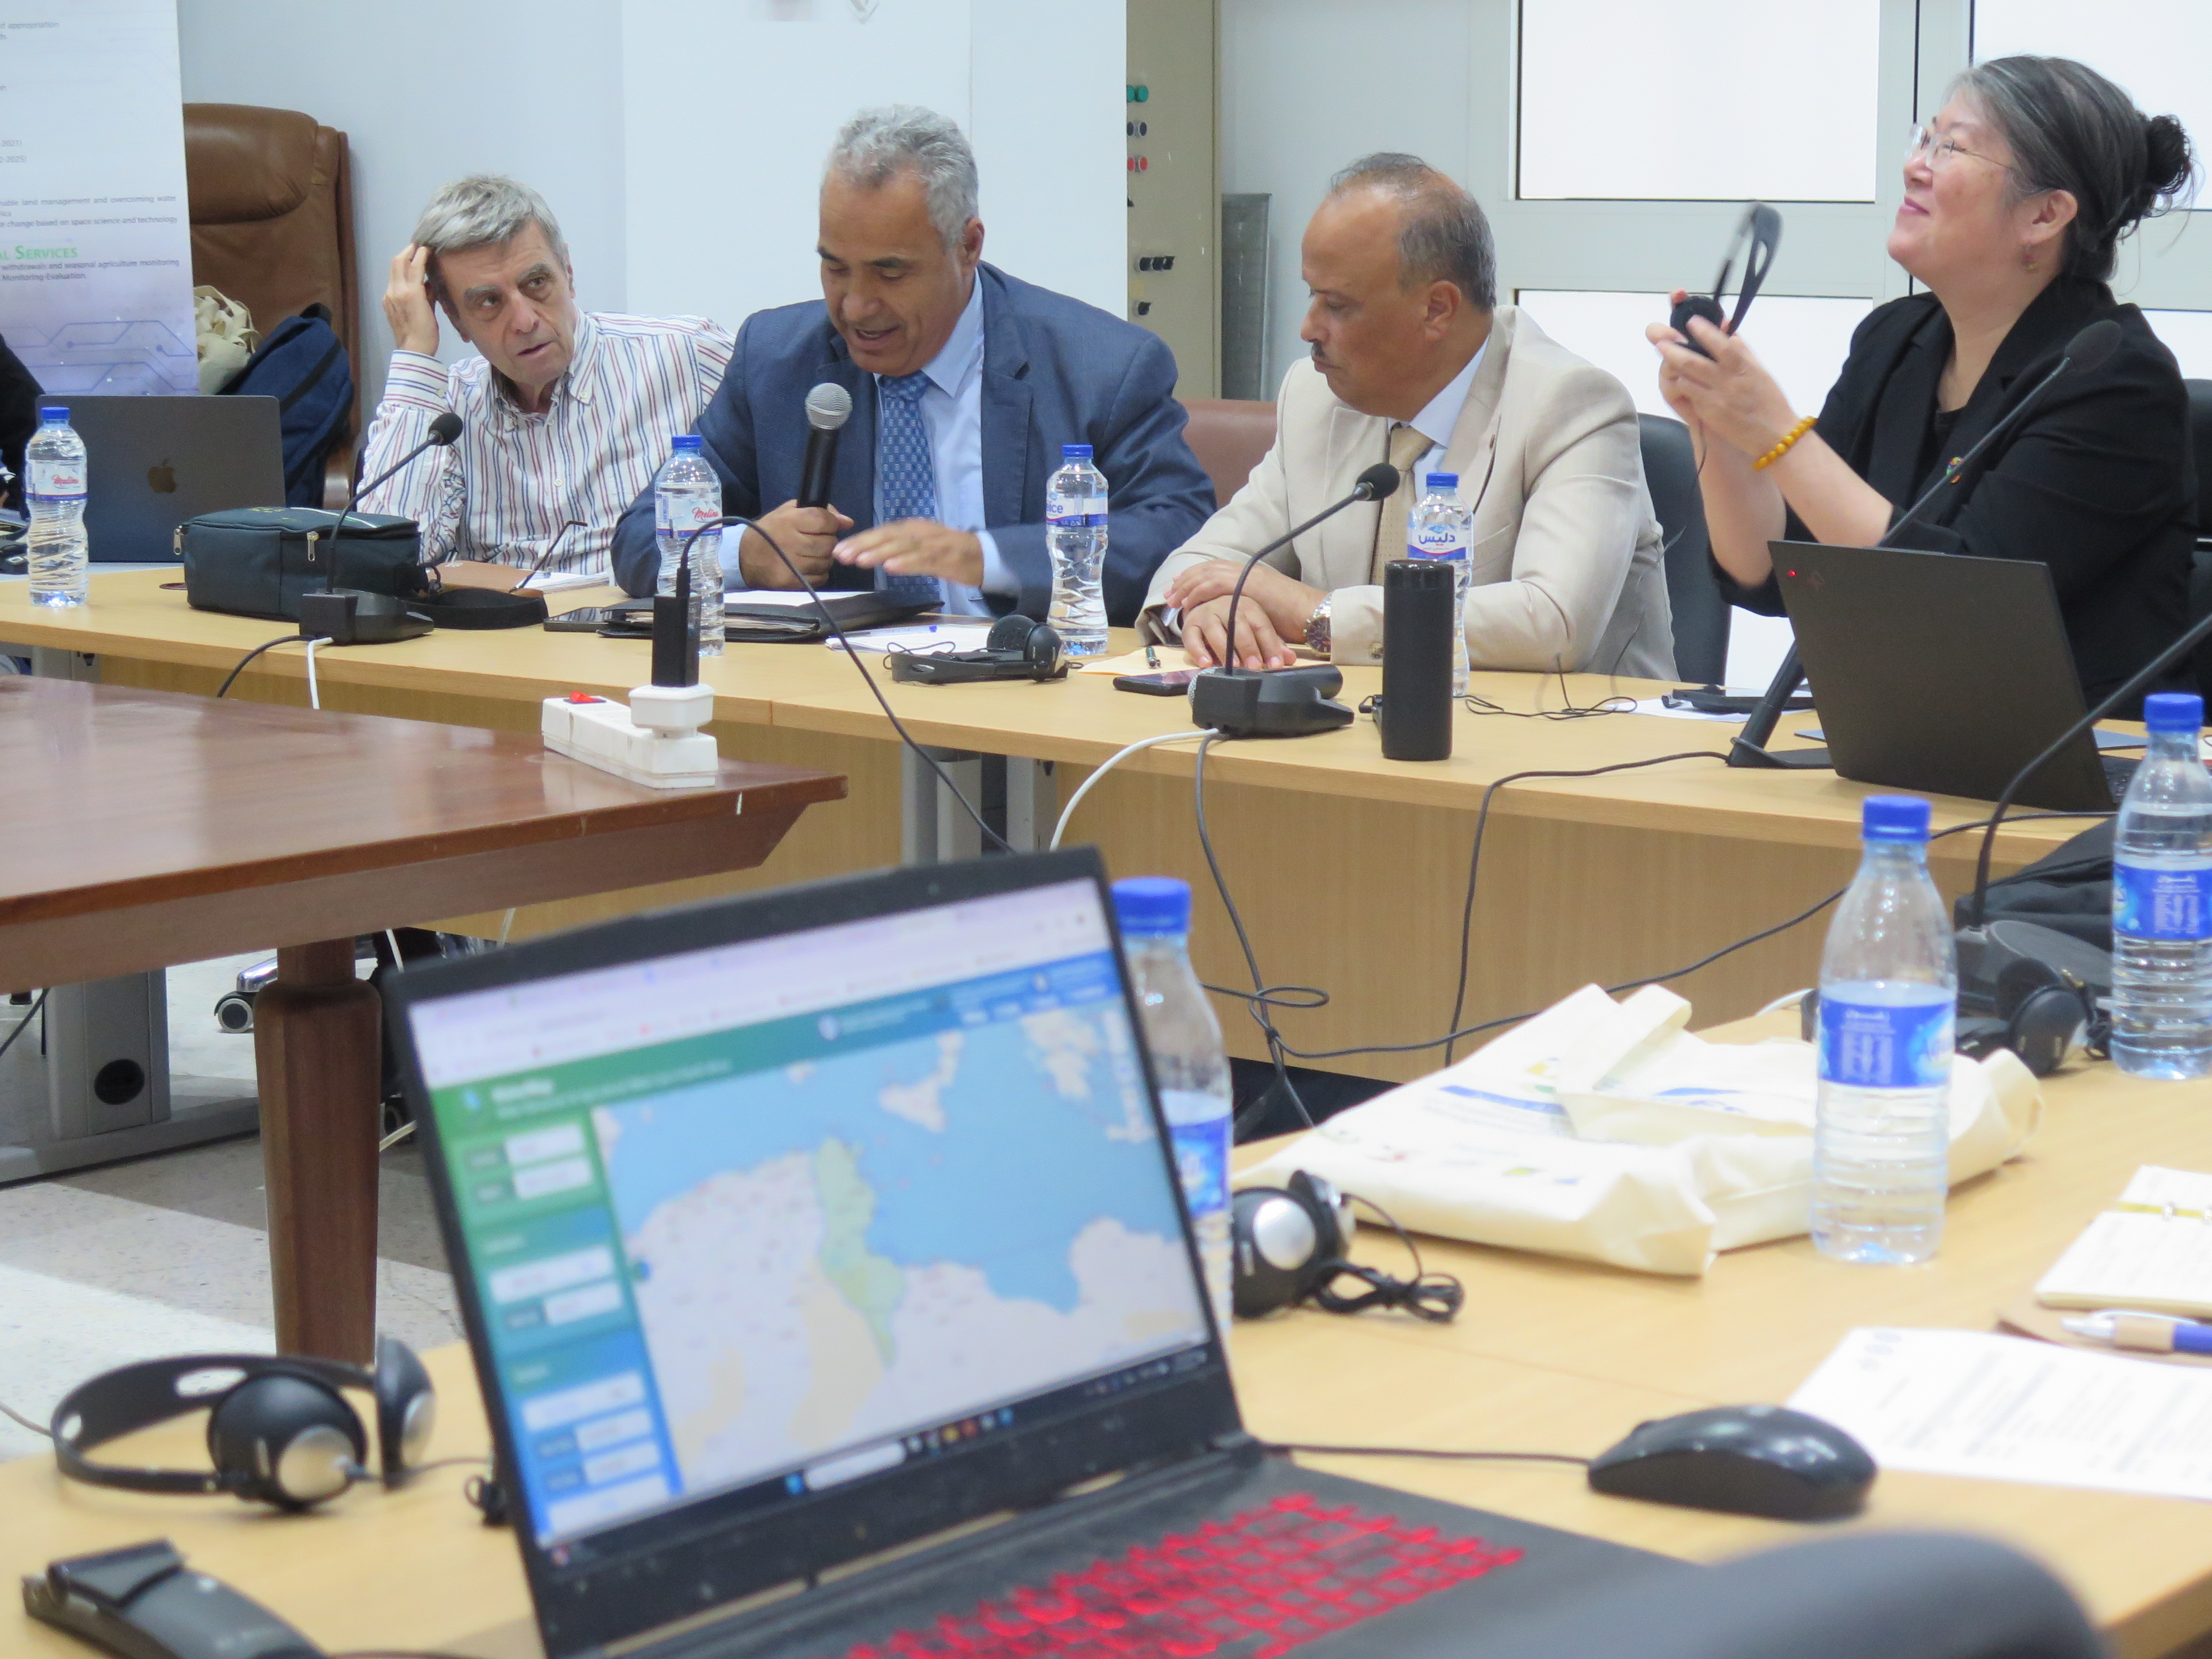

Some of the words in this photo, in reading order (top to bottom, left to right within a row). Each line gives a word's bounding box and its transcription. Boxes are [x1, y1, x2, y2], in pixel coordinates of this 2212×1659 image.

[41, 198, 91, 206] management
[111, 196, 154, 204] overcoming
[7, 220, 35, 229] change
[98, 260, 138, 269] agriculture
[1417, 533, 1455, 545] دليس
